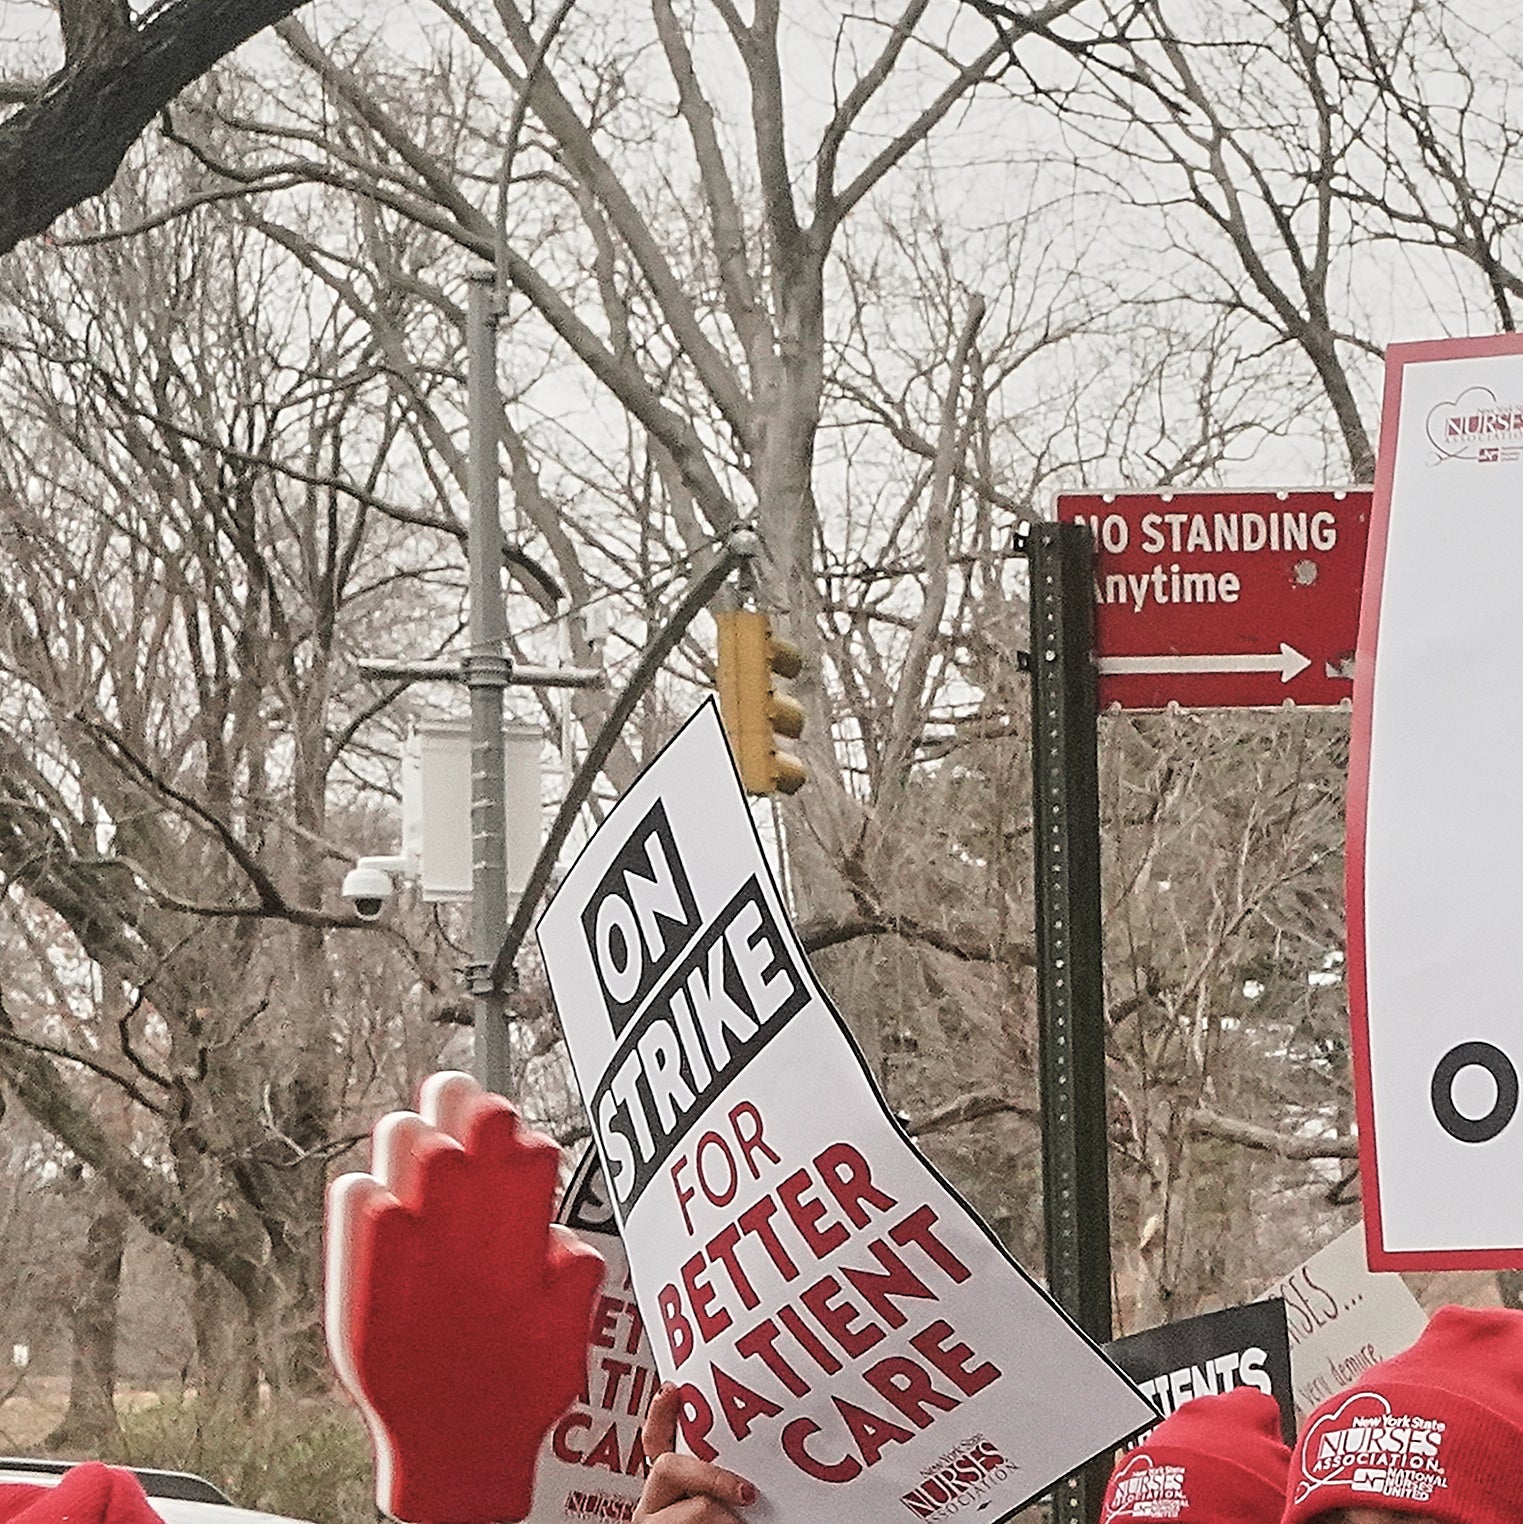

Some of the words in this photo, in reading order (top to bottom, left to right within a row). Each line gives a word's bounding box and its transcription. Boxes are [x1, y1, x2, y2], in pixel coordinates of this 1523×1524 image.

[1141, 511, 1337, 553] STANDING
[1094, 563, 1241, 614] nytime
[595, 830, 689, 1004] ON
[598, 899, 795, 1205] STRIKE
[670, 1100, 781, 1236] FOR
[657, 1142, 899, 1371] BETTER
[678, 1204, 973, 1463] PATIENT
[780, 1318, 1003, 1484] CARE
[1353, 1416, 1381, 1429] New
[1382, 1413, 1411, 1429] York
[1411, 1416, 1447, 1433] State
[1318, 1426, 1443, 1459] NURSES
[900, 1440, 1005, 1520] NURSES
[1382, 1485, 1430, 1502] UNITED
[1385, 1476, 1435, 1494] NURSES
[1387, 1466, 1449, 1489] NATIONAL
